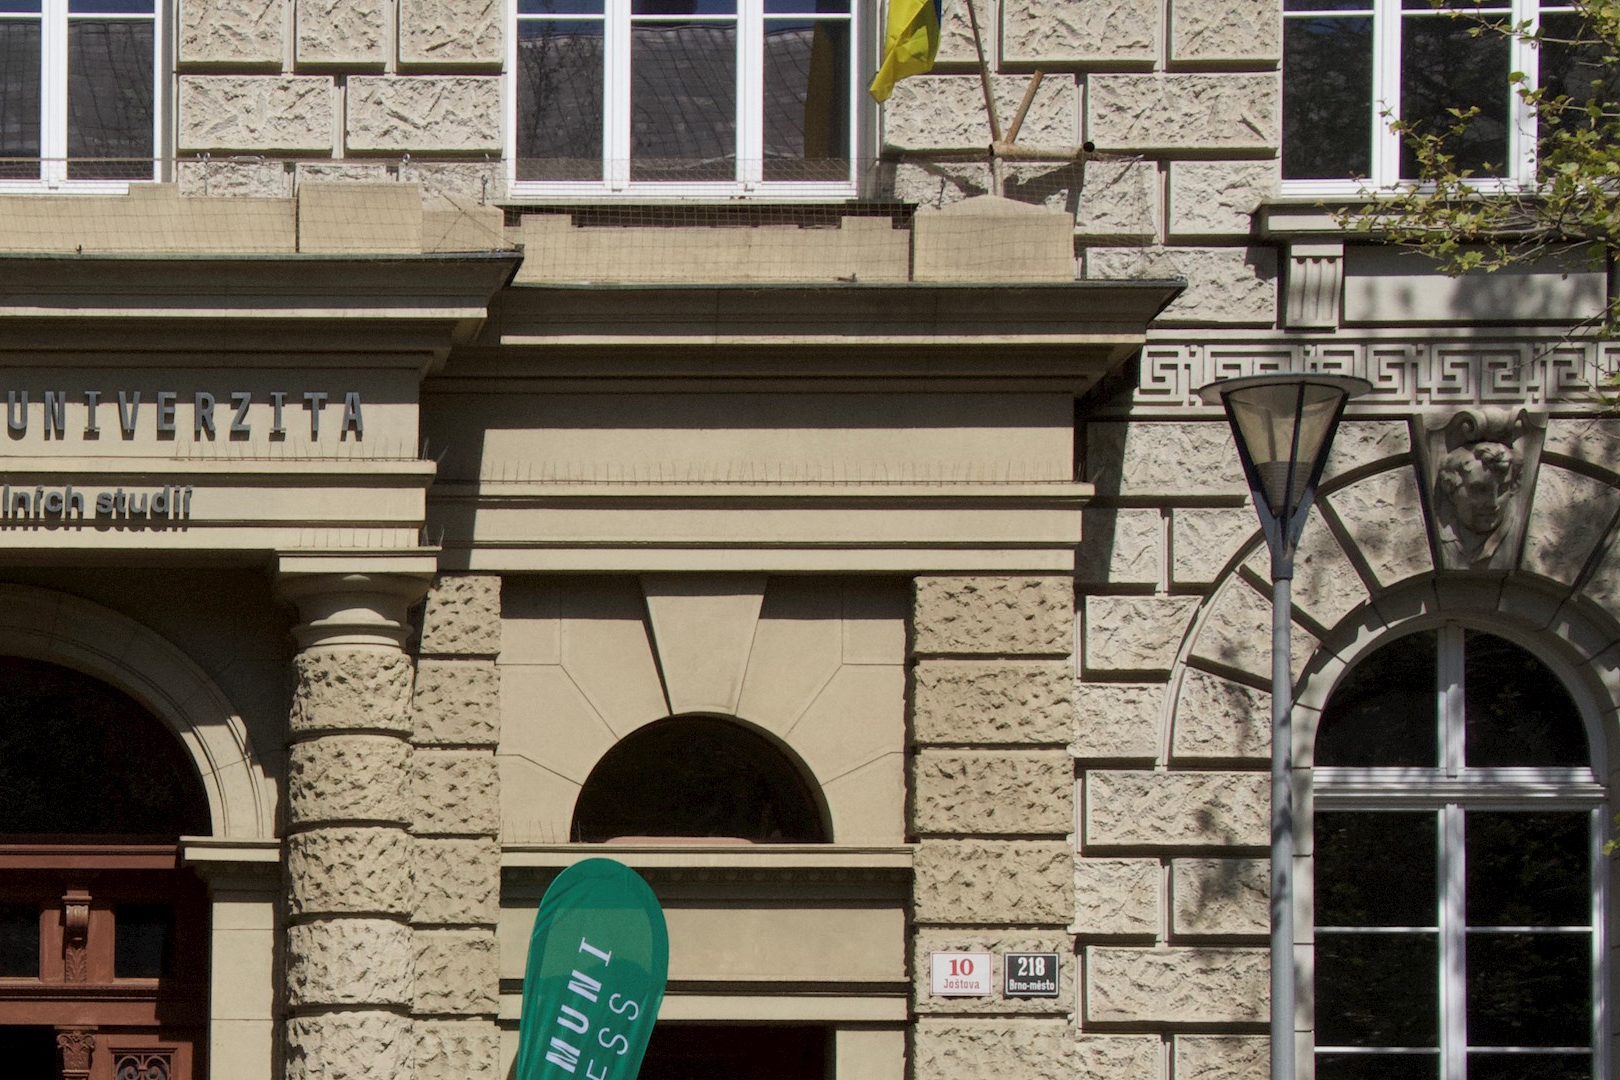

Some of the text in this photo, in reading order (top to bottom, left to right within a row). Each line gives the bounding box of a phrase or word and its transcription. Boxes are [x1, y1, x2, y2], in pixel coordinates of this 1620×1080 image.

[6, 390, 364, 434] UNIVERZITA
[95, 484, 193, 514] studií
[948, 958, 974, 976] 10
[1017, 956, 1045, 976] 218
[943, 978, 980, 989] Joštova
[1009, 978, 1055, 990] Brno-město
[545, 936, 612, 1073] MUNI
